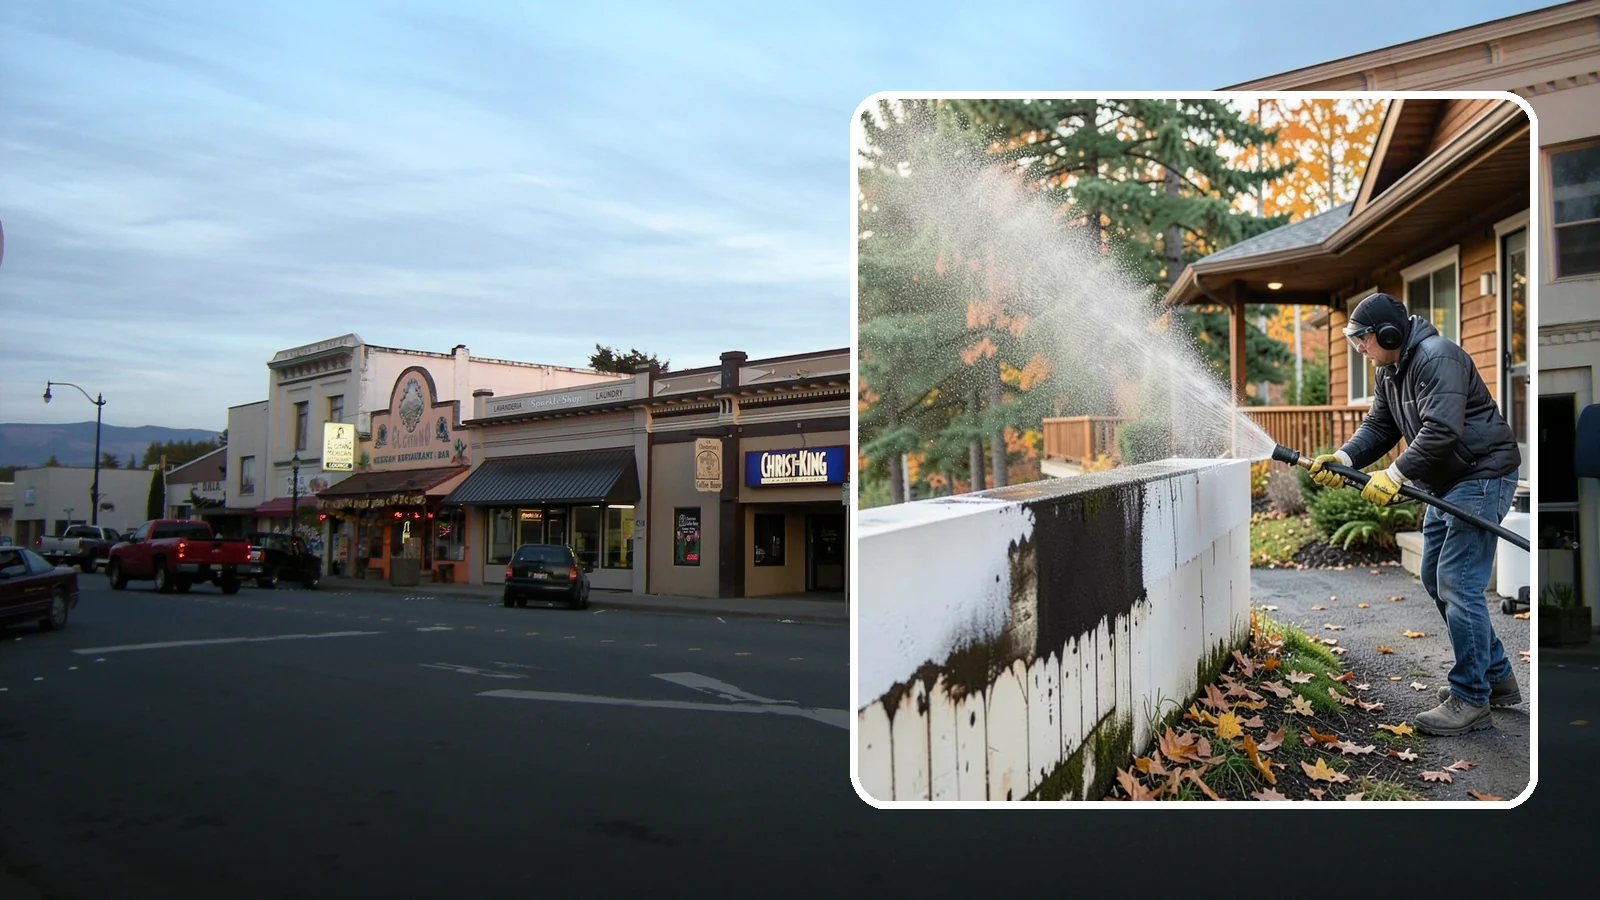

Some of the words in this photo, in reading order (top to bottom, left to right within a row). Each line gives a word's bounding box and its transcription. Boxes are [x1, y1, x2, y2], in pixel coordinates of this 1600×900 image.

[564, 395, 582, 404] Shop
[595, 389, 624, 400] LAUNDRY
[374, 455, 396, 464] MEXICAN
[397, 451, 433, 462] RESTAURANT
[438, 450, 449, 459] BAR
[799, 450, 827, 476] KING
